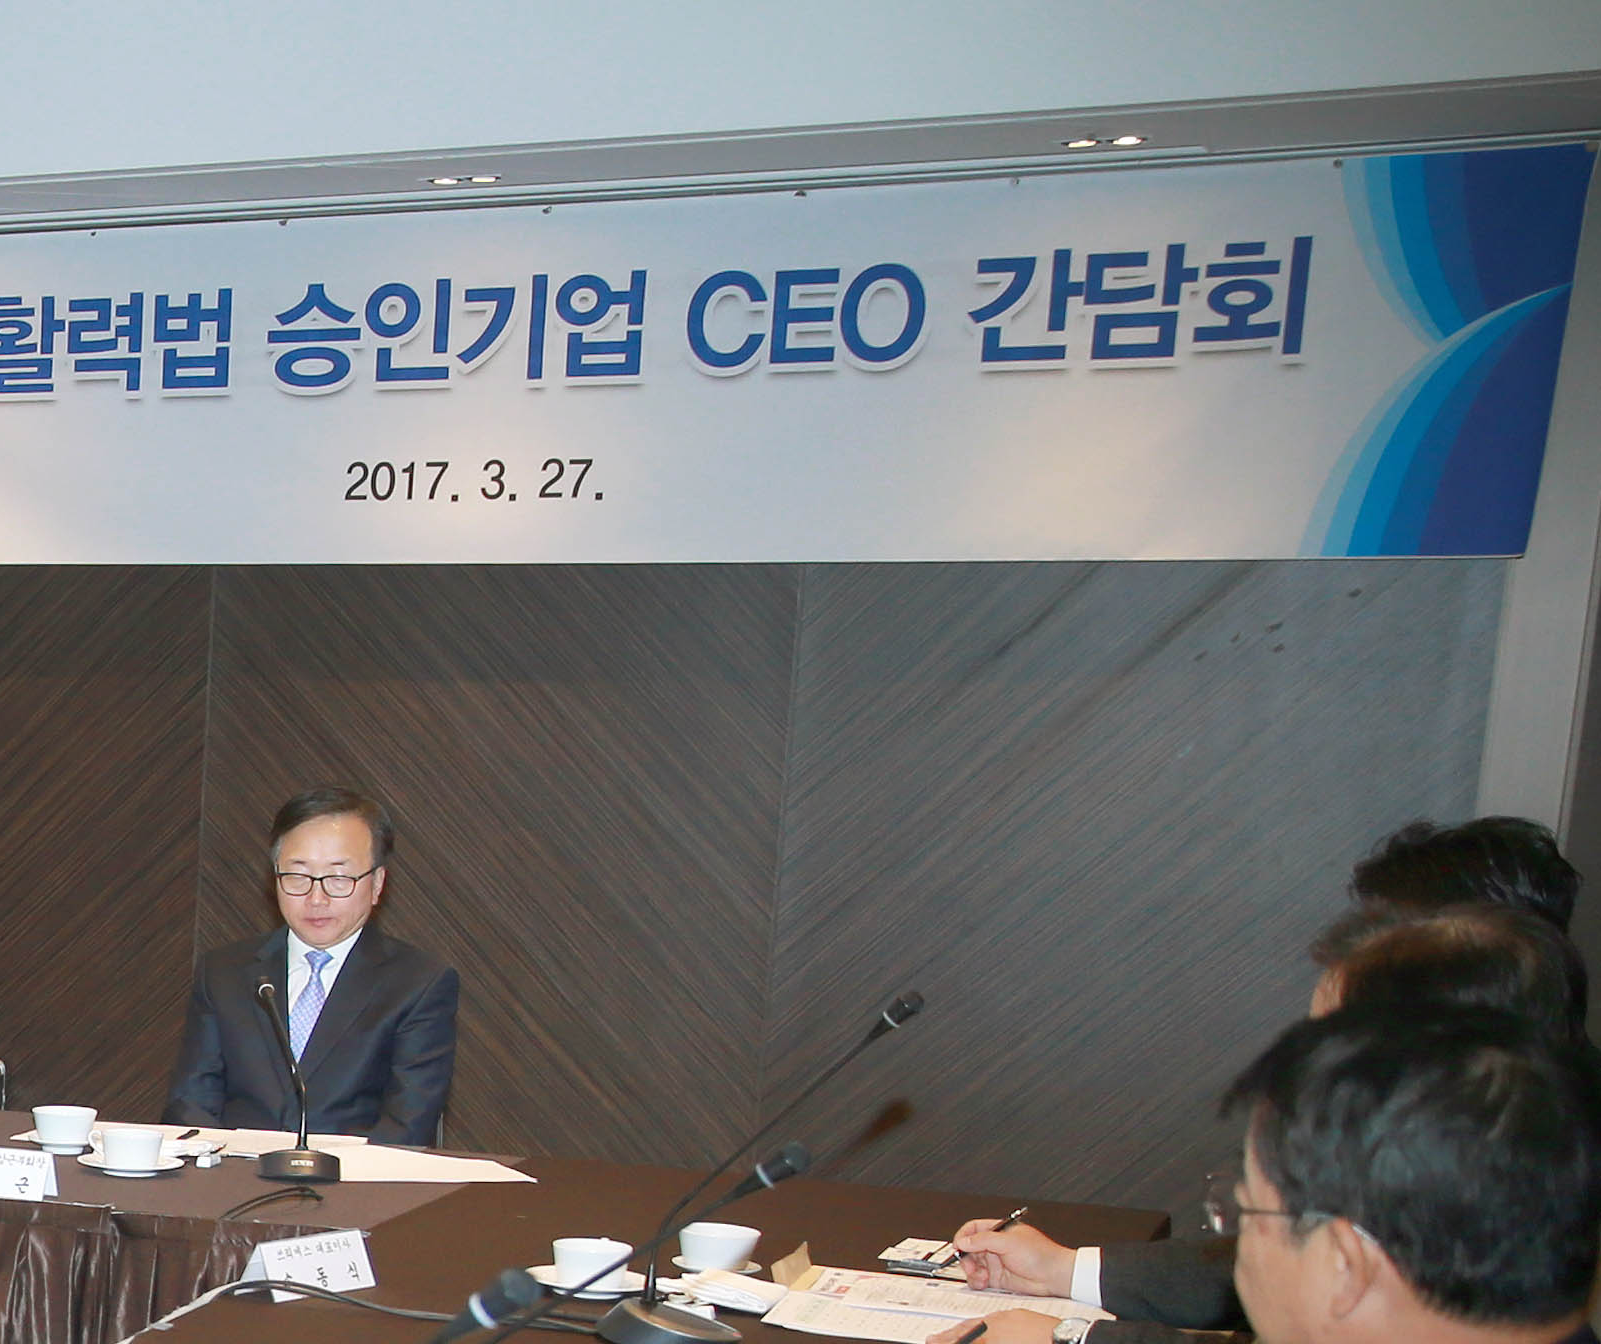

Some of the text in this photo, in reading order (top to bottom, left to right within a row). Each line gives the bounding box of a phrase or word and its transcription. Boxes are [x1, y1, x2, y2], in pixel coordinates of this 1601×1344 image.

[267, 268, 648, 388] 승인기업
[687, 261, 928, 368] CEO
[969, 235, 1314, 362] 간담회
[344, 457, 604, 502] 2017. 3. 27.
